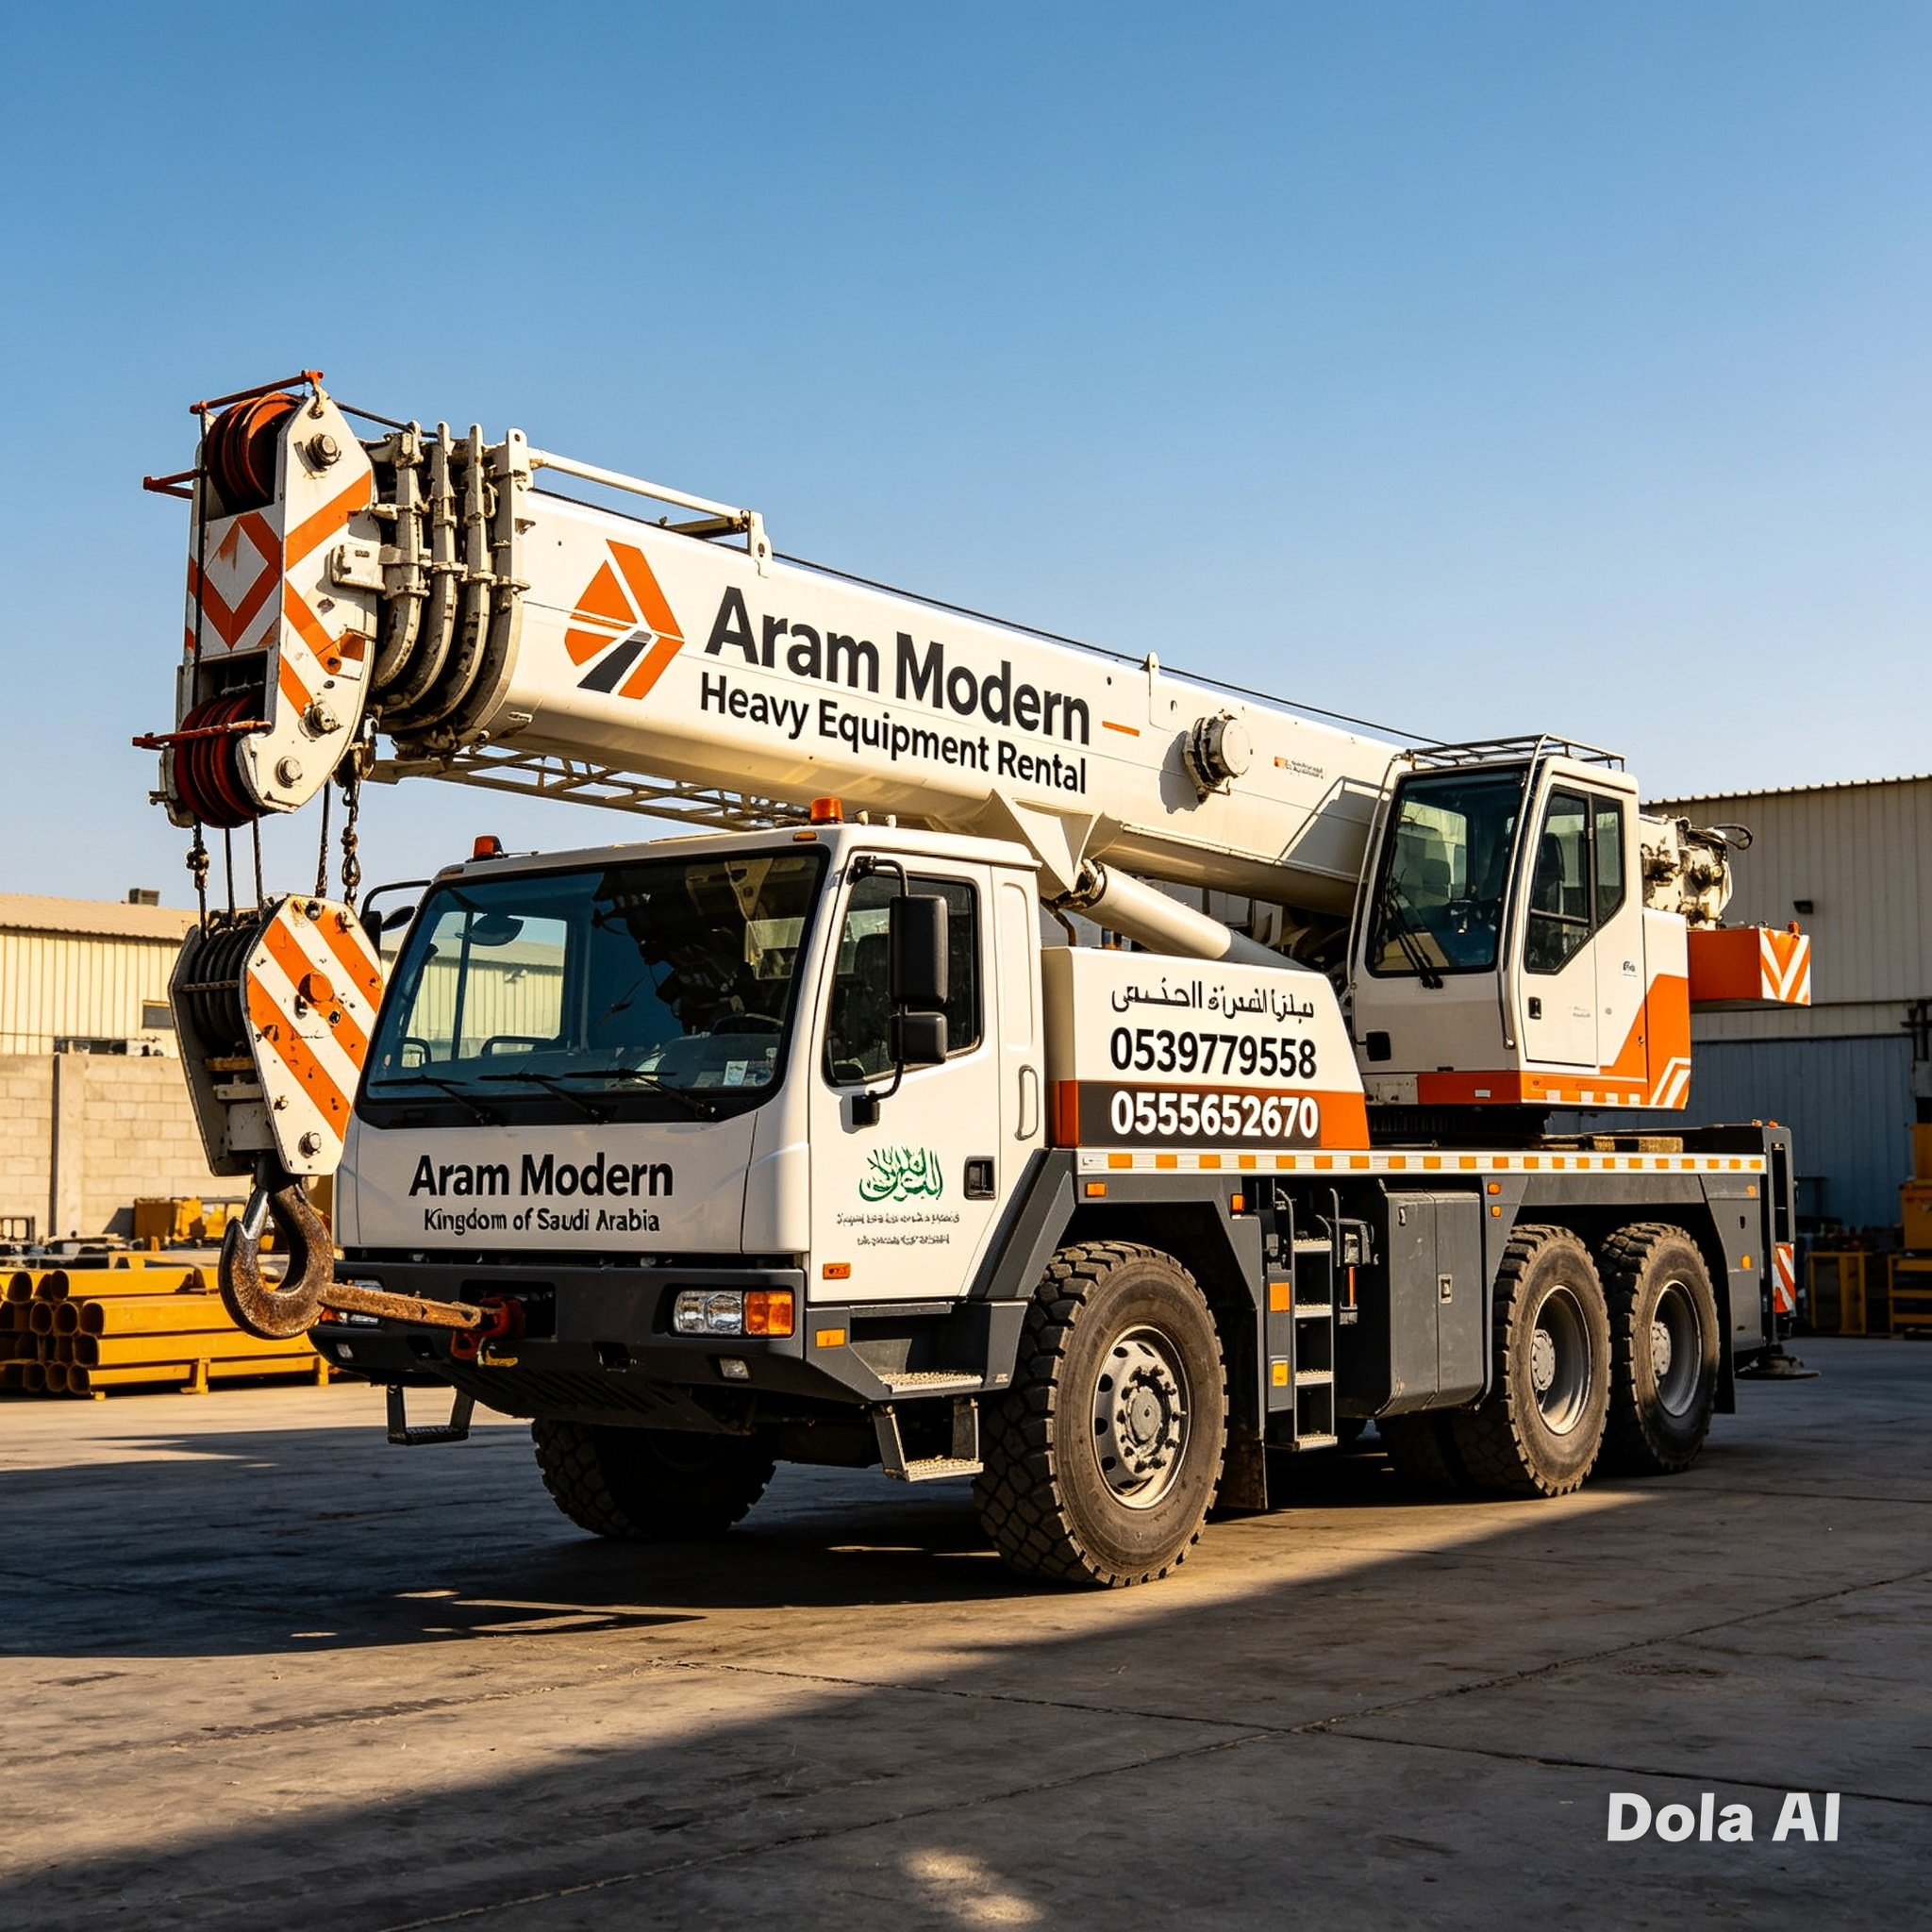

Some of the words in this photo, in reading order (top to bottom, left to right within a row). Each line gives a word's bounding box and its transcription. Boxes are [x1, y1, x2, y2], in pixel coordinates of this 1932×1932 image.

[705, 586, 879, 693] Aram
[896, 631, 1091, 746] Modern
[700, 672, 809, 741] Heavy
[819, 699, 990, 773] Equipment
[997, 740, 1087, 794] Rental
[1110, 1026, 1317, 1079] 0539779558
[1111, 1091, 1319, 1139] 0555652670
[408, 1155, 509, 1197] Aram
[520, 1152, 674, 1197] Modern
[424, 1208, 508, 1237] Kingdom
[512, 1207, 534, 1231] of
[537, 1208, 590, 1232] Saudi
[595, 1208, 660, 1232] Arabia
